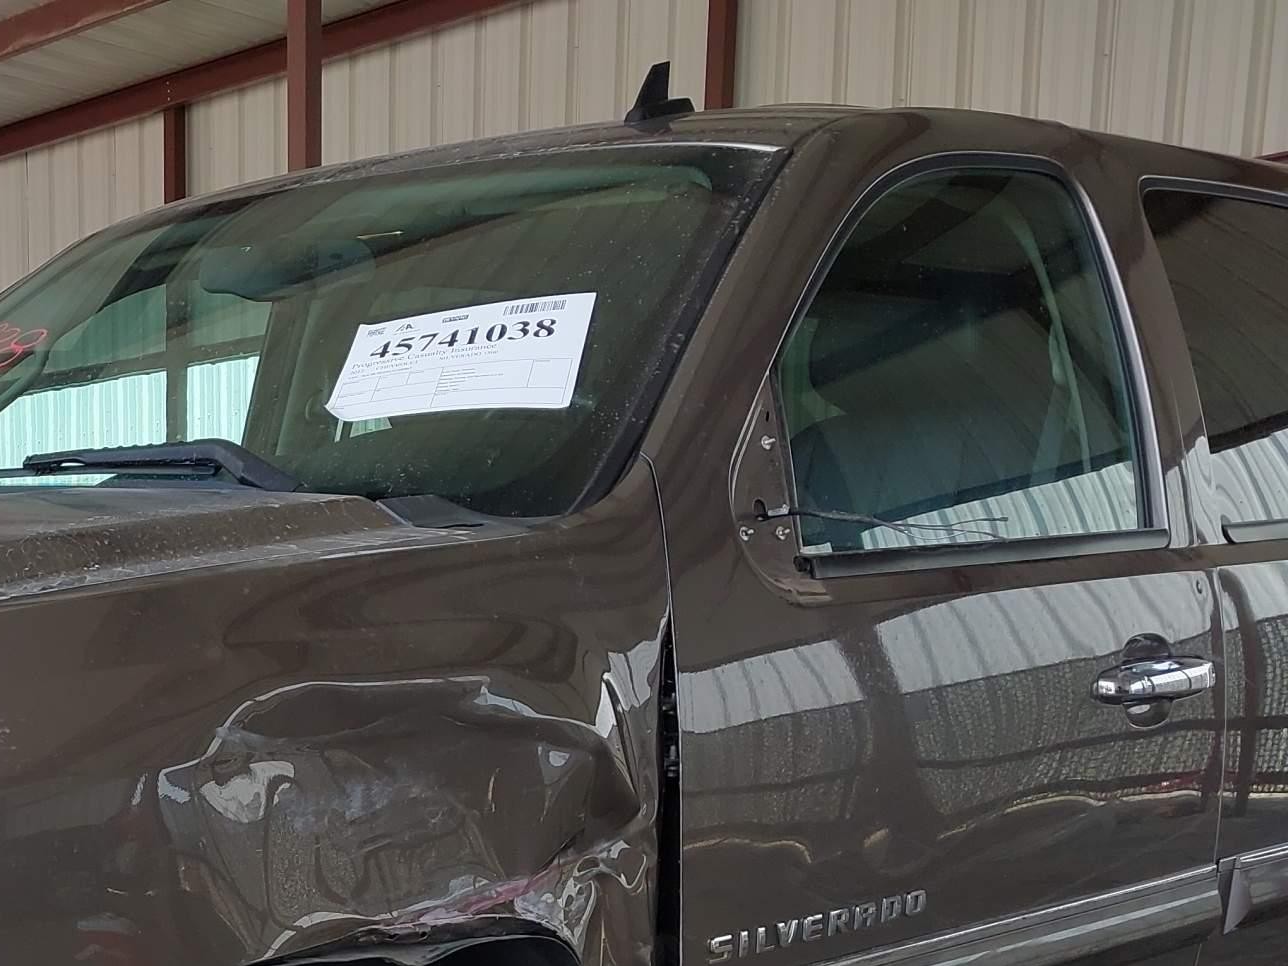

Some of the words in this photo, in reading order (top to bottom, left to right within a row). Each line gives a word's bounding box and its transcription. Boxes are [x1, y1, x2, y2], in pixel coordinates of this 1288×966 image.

[369, 318, 557, 359] 45741038
[451, 343, 498, 354] Insurance
[706, 889, 928, 964] SILVERADO
